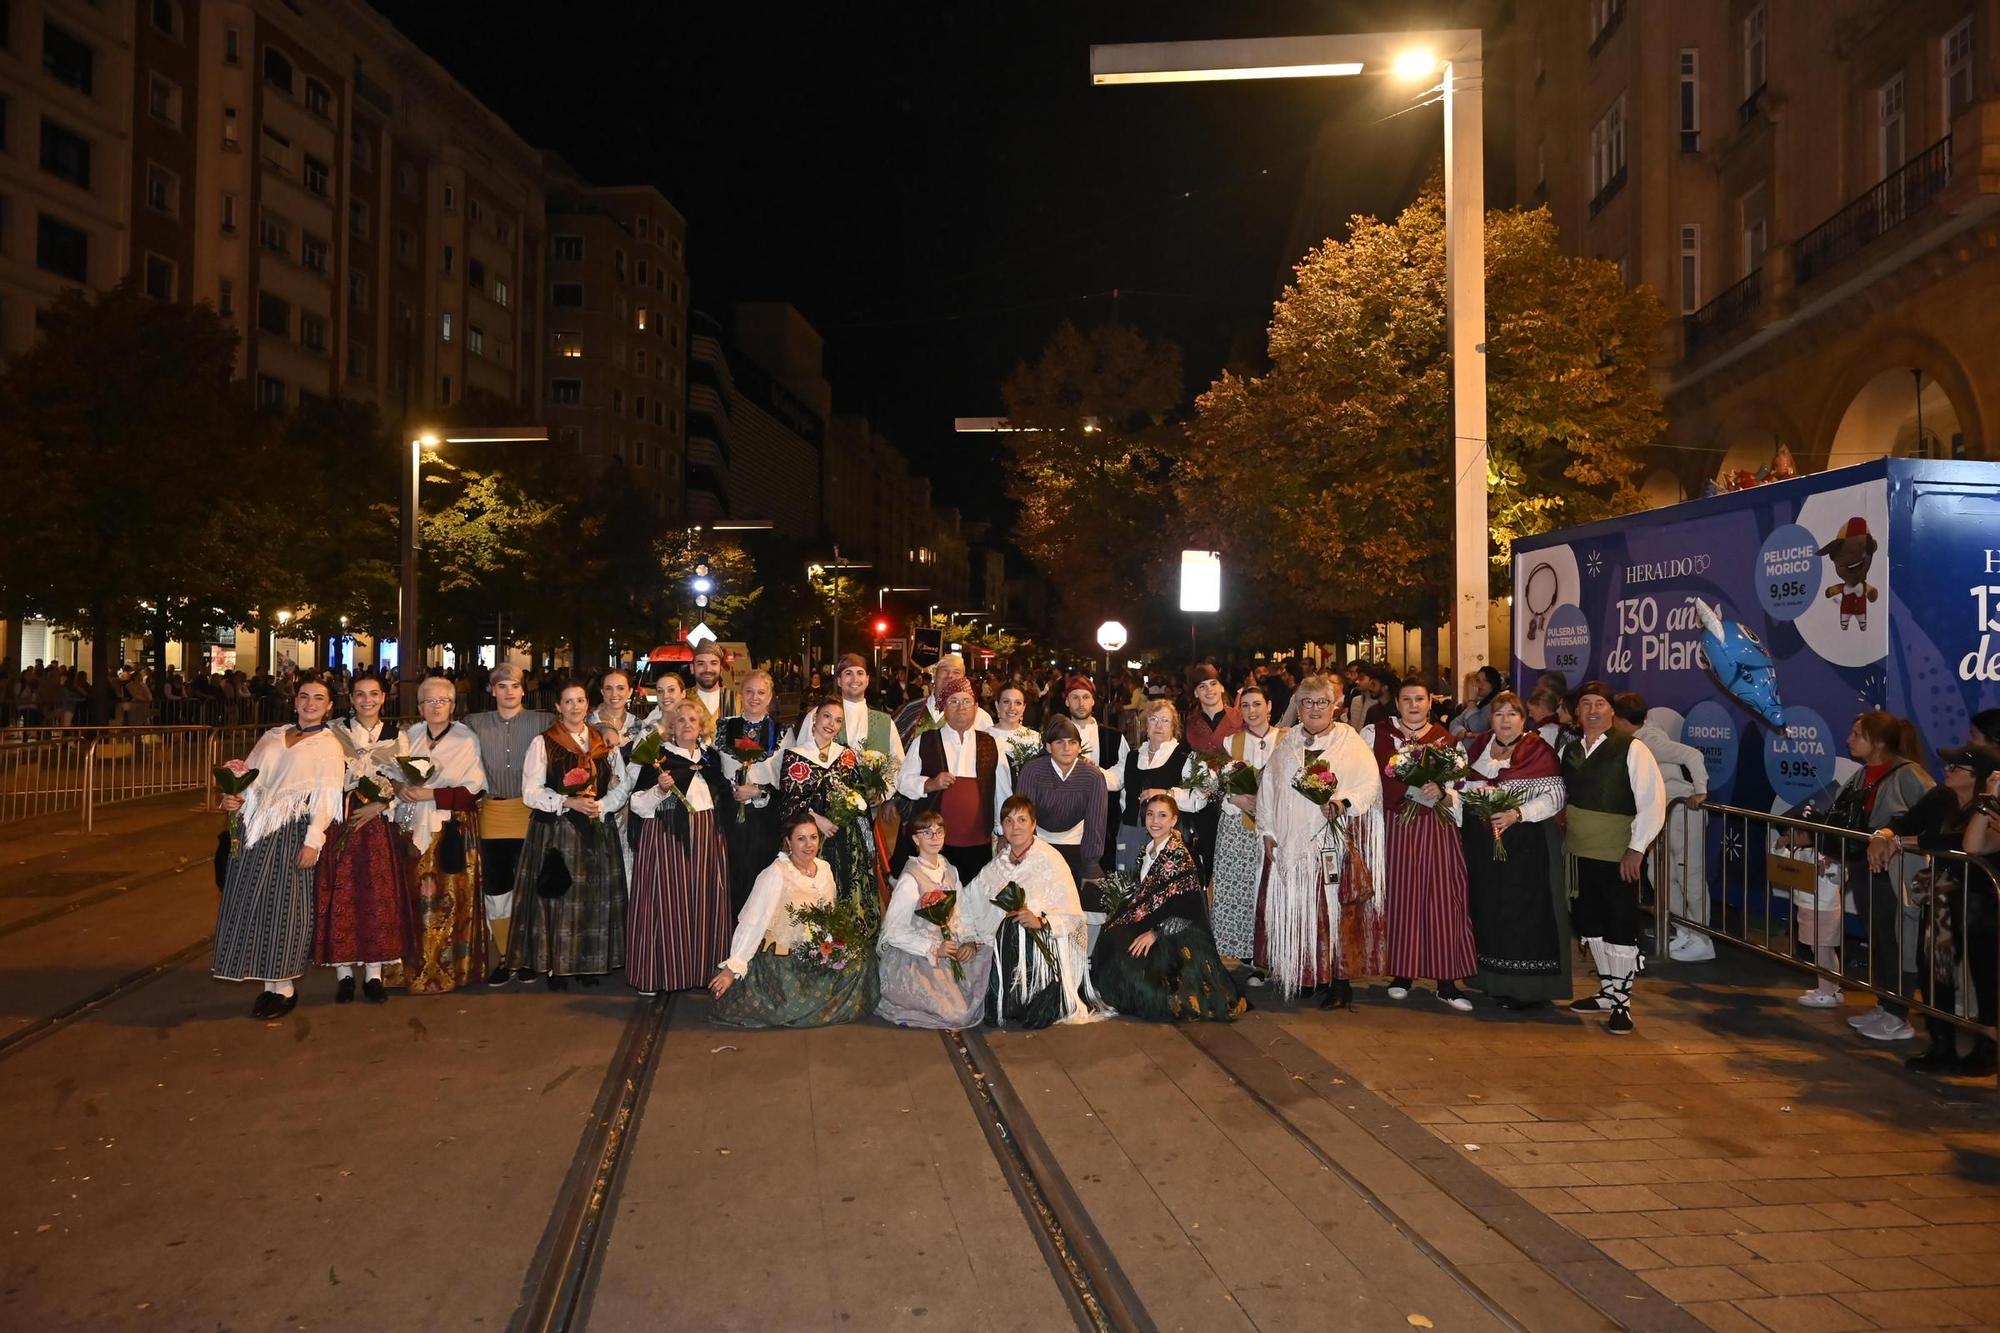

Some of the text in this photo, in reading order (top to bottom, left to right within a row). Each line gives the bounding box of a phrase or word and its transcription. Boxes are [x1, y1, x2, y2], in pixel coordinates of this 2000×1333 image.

[1763, 545, 1814, 564] PELUCHE
[1626, 557, 1692, 583] HERALDO
[1766, 560, 1810, 577] MORICO
[1770, 580, 1807, 601] 9,95€
[1616, 596, 1723, 635] 130 añ
[1547, 626, 1576, 637] PULSERA
[1546, 635, 1590, 648] ANIVERSARIO
[1556, 654, 1578, 668] 6,95€
[1606, 635, 1633, 674] de
[1687, 726, 1732, 740] BROCHE
[1781, 726, 1817, 740] IBRO
[1773, 740, 1825, 755] LA JOTA
[1780, 760, 1818, 778] 9,95€
